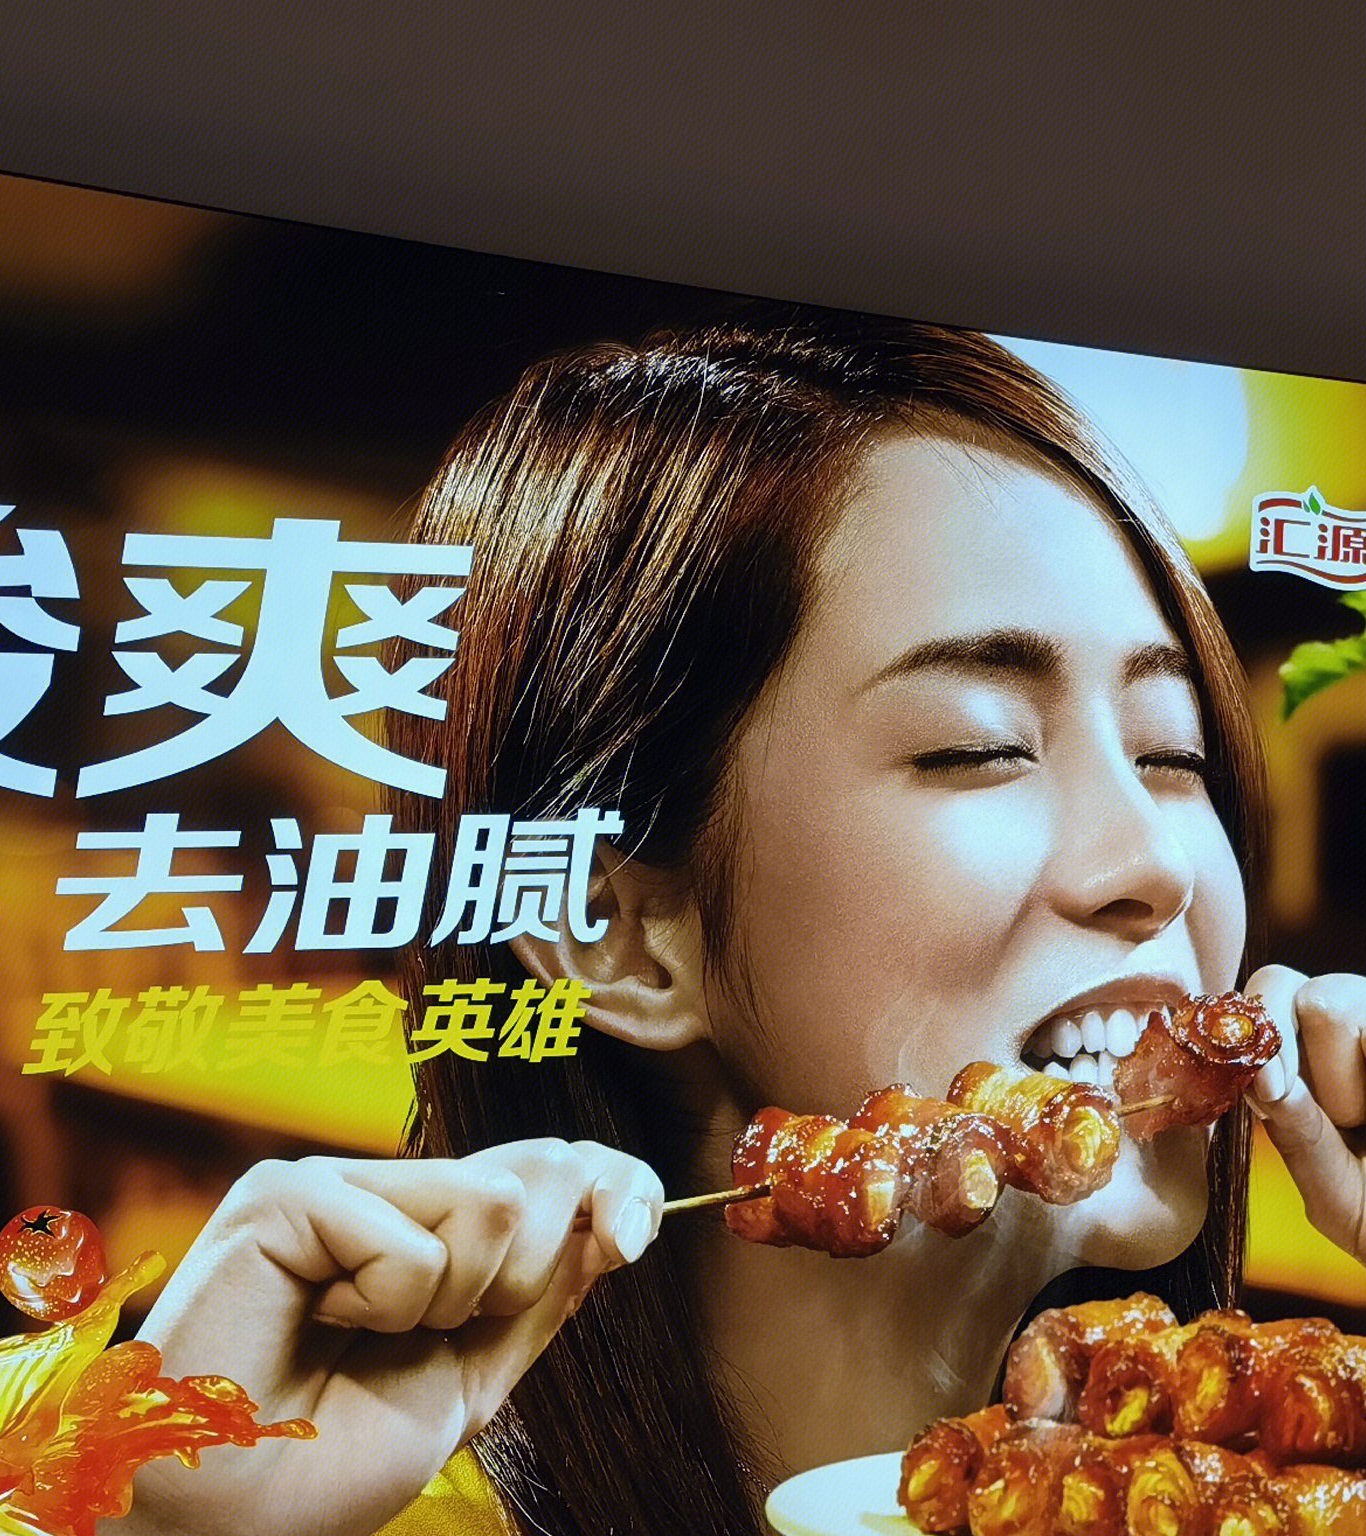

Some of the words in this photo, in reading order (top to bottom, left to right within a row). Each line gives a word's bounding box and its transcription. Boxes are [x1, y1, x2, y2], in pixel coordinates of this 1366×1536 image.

[55, 807, 624, 953] 去油腻
[22, 978, 592, 1075] 致敬美食英雄
